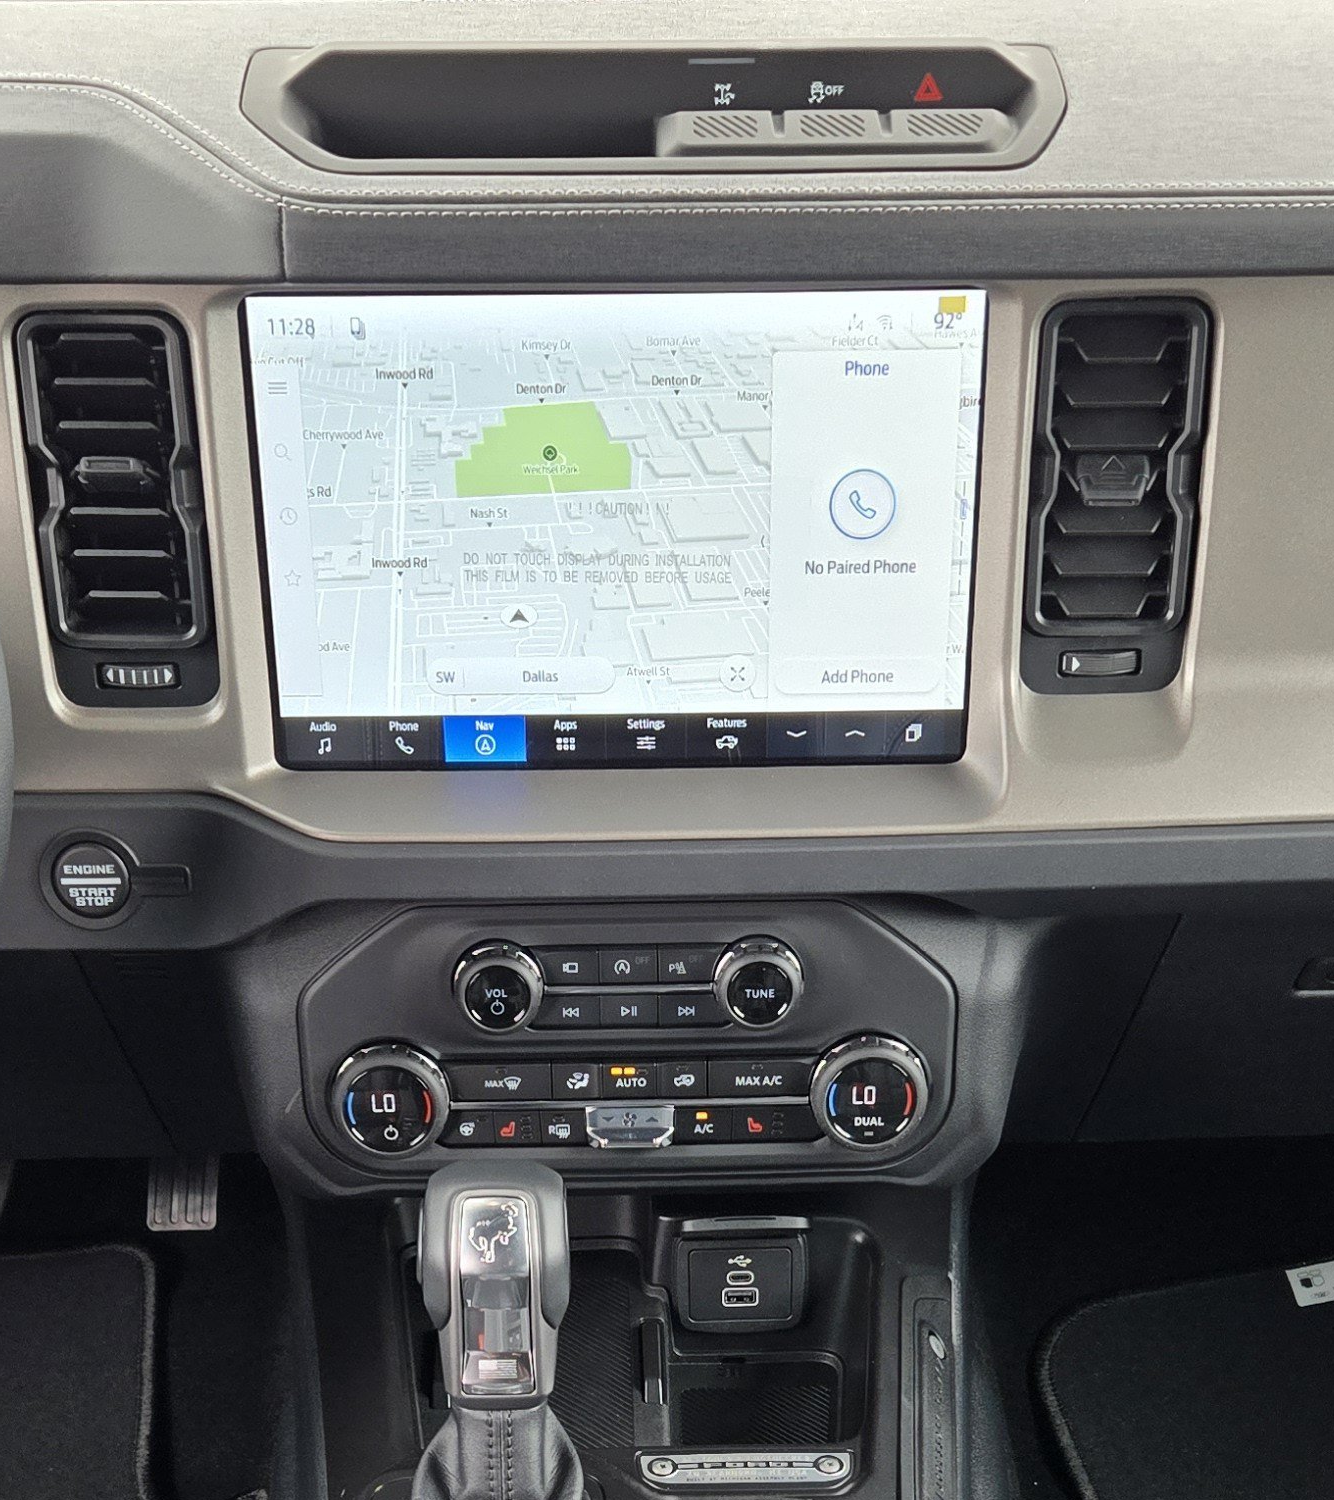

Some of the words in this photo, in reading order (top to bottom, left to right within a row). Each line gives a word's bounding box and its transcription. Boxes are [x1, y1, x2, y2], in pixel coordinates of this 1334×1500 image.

[825, 85, 845, 95] OFF
[267, 318, 315, 336] 11:28
[934, 313, 963, 329] 92°
[521, 339, 557, 353] Kimsey
[560, 339, 571, 351] Dr
[682, 335, 701, 347] Ave
[375, 368, 416, 380] Inwood
[418, 368, 434, 380] Rd
[845, 362, 890, 376] Phone
[651, 375, 688, 387] Denton
[690, 375, 702, 387] Dr
[516, 383, 552, 395] Denton
[554, 383, 566, 395] Dr
[302, 429, 363, 443] Cherrywood
[365, 429, 384, 440] Ave
[560, 464, 578, 474] Park
[317, 486, 332, 498] Rd
[470, 508, 495, 519] Nash
[497, 508, 508, 519] St
[371, 557, 411, 569] Inwood
[413, 557, 428, 569] Rd
[464, 553, 479, 564] DO
[486, 553, 508, 565] NOT
[514, 553, 551, 565] TOUCH
[558, 553, 600, 566] DISPLAY
[609, 554, 650, 566] DURING
[655, 554, 731, 567] INSTALLATION
[805, 561, 824, 574] No
[827, 561, 871, 575] Paired
[873, 560, 917, 575] Phone
[465, 570, 488, 582] THIS
[495, 570, 519, 582] FILM
[526, 570, 536, 582] IS
[542, 570, 557, 582] TO
[563, 570, 578, 582] BE
[585, 571, 638, 583] REMOVED
[645, 571, 688, 583] BEFORE
[695, 571, 732, 583] USAGE
[436, 672, 455, 683] SW
[523, 671, 558, 683] Dallas
[627, 667, 657, 678] Atwell
[660, 667, 670, 678] St
[821, 671, 848, 684] Add
[851, 670, 894, 684] Phone
[310, 721, 337, 732] Audio
[389, 721, 419, 732] Phone
[475, 721, 494, 732] Nav
[553, 719, 577, 732] Apps
[627, 718, 665, 731] Settings
[707, 718, 747, 729] Features
[63, 864, 115, 875] ENGINE
[69, 887, 116, 897] START
[75, 897, 114, 907] STOP
[485, 988, 508, 999] VOL
[744, 988, 776, 1000] TUNE
[484, 1080, 504, 1088] MAX
[616, 1078, 647, 1088] AUTO
[735, 1076, 761, 1086] MAX
[762, 1075, 782, 1087] A/C
[852, 1085, 876, 1105] LO
[371, 1093, 396, 1113] LO
[854, 1117, 884, 1127] DUAL
[694, 1123, 714, 1134] A/C
